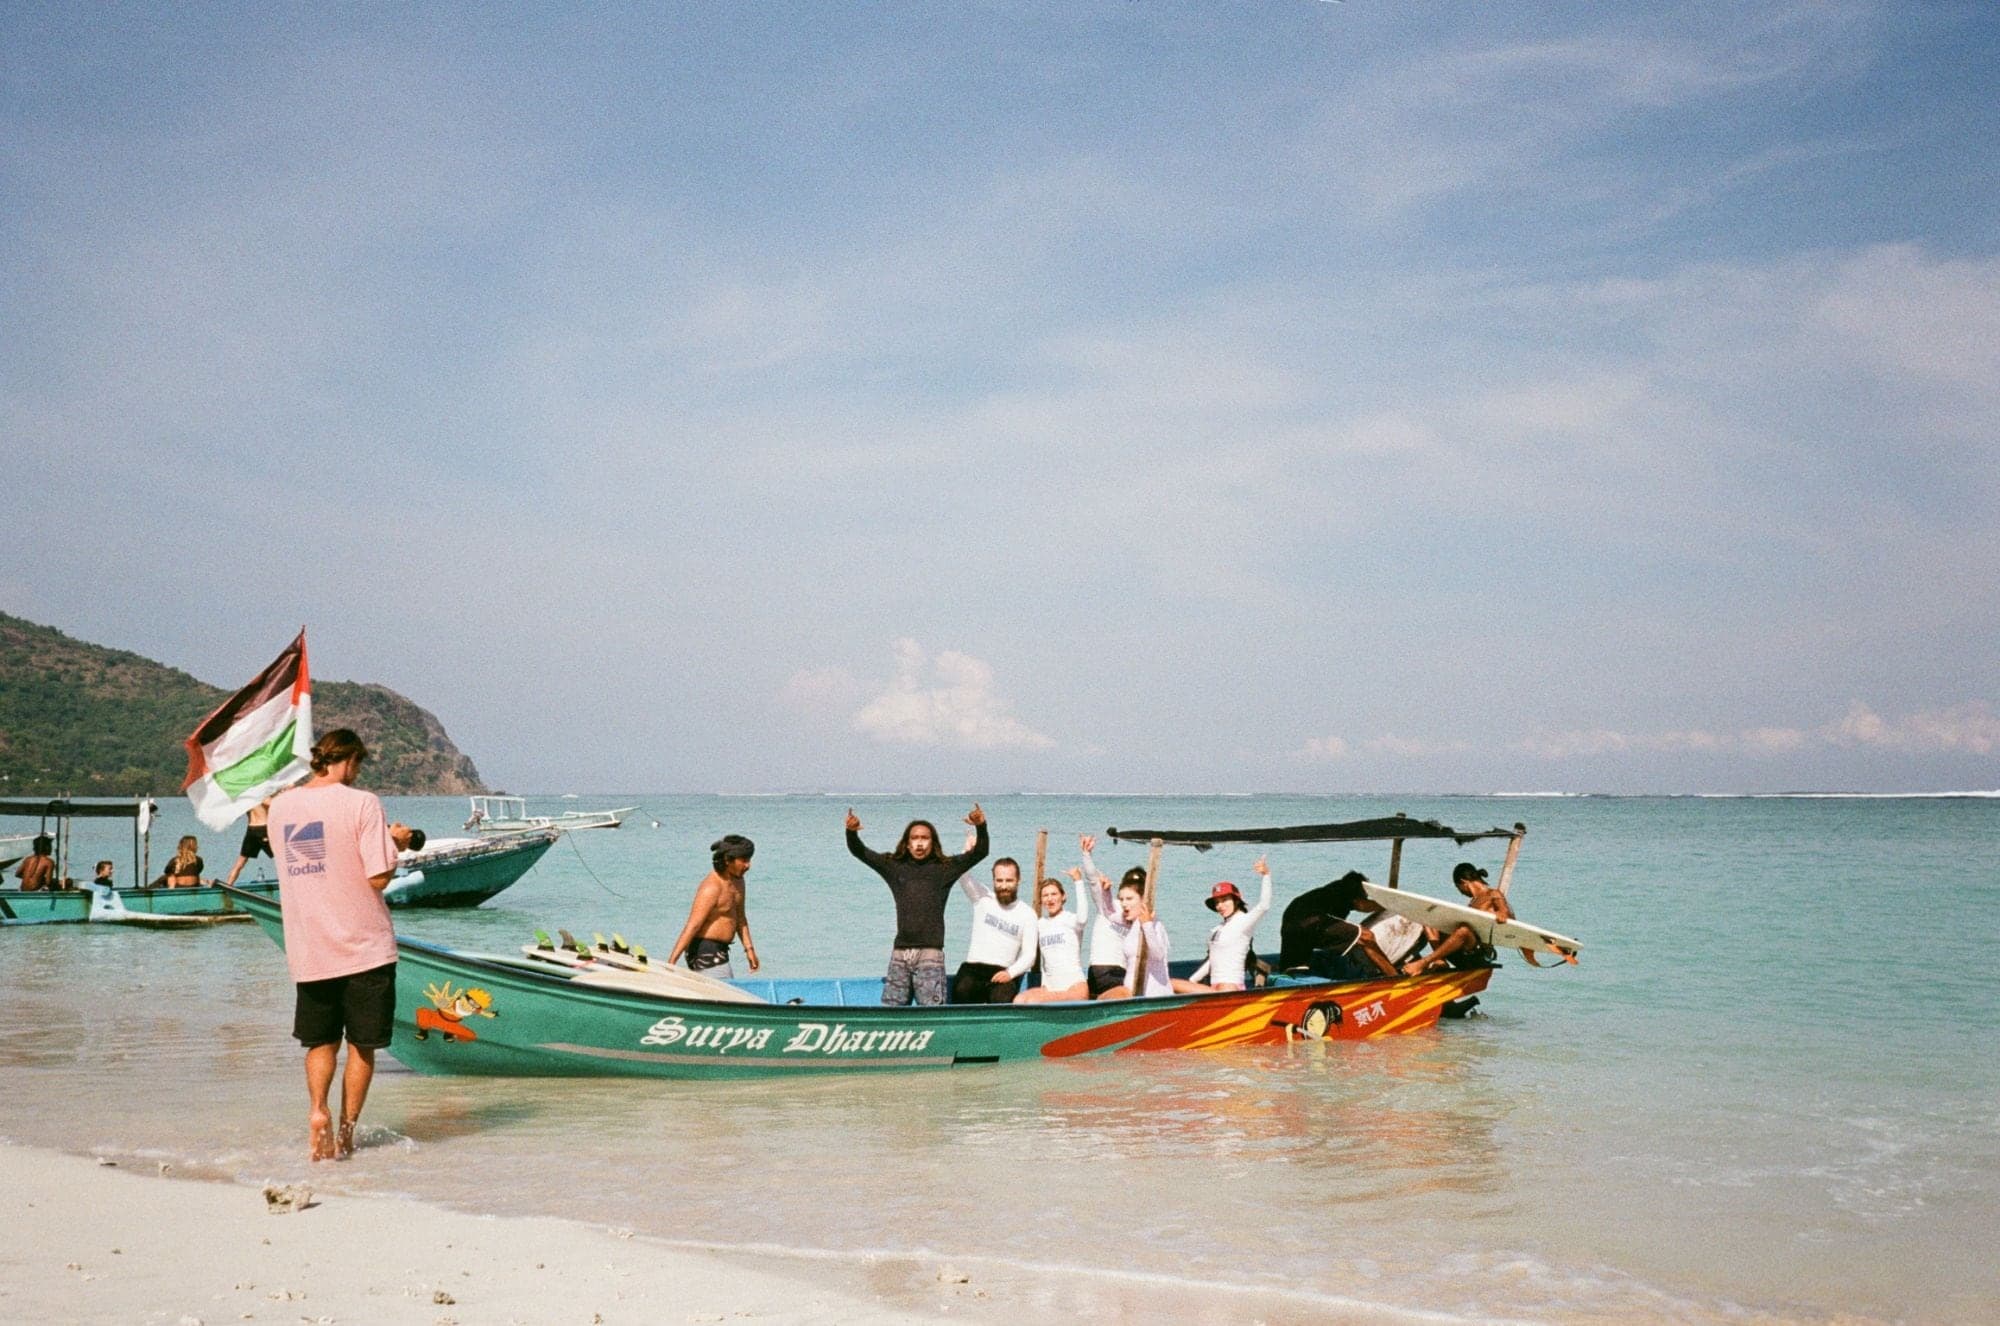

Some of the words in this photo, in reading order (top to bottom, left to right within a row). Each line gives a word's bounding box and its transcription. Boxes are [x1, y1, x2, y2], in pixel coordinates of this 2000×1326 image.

[287, 861, 326, 877] Kodak
[640, 1016, 774, 1054] Surya
[782, 1022, 935, 1054] Dharma
